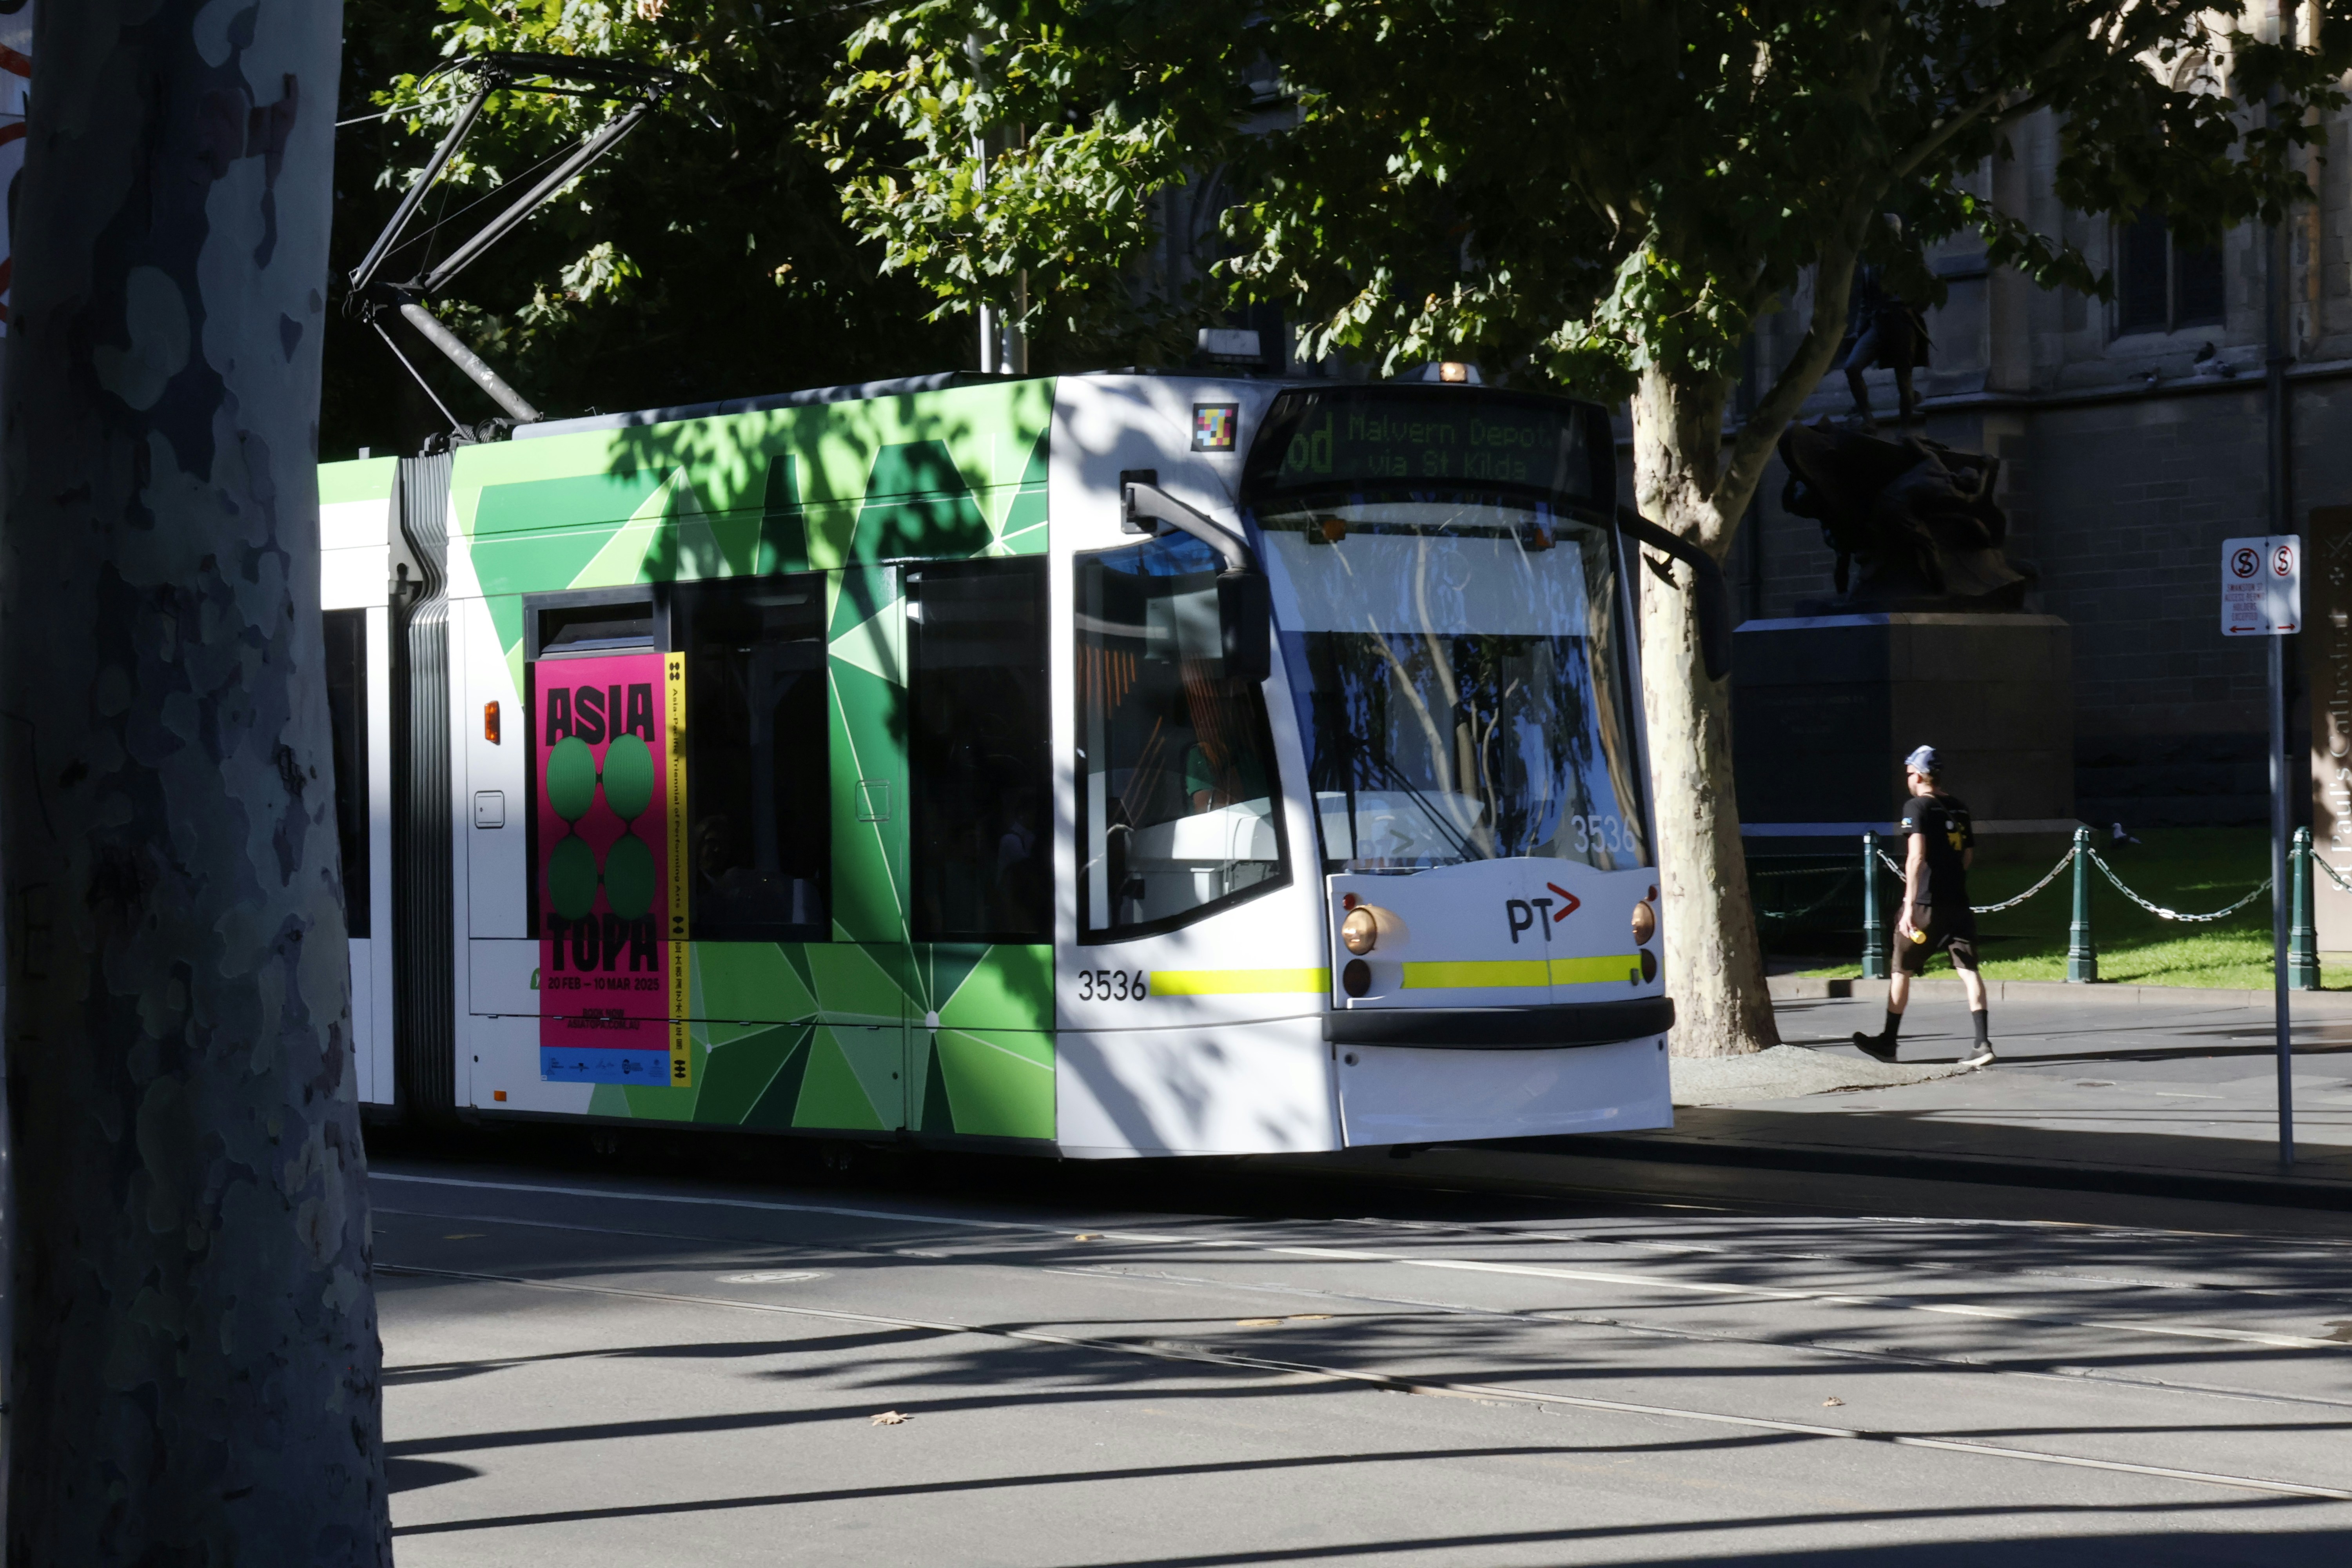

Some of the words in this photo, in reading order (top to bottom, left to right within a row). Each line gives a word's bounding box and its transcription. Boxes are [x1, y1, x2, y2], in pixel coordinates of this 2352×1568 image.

[1348, 413, 1455, 445] Malvern
[1368, 448, 1408, 477] via
[1423, 449, 1448, 478] St
[1463, 451, 1526, 481] Kilda
[2328, 614, 2351, 758] Cathedral
[545, 683, 655, 746] ASIA
[674, 808, 680, 818] of
[2329, 768, 2352, 852] Paul's
[1570, 814, 1636, 853] 3536
[2332, 860, 2352, 892] St
[547, 913, 659, 972] TOPA
[548, 977, 560, 989] 20
[563, 977, 581, 989] FEB
[594, 977, 605, 990] 10
[607, 978, 631, 991] MAR
[634, 978, 659, 991] 2025
[1078, 970, 1146, 1001] 3536
